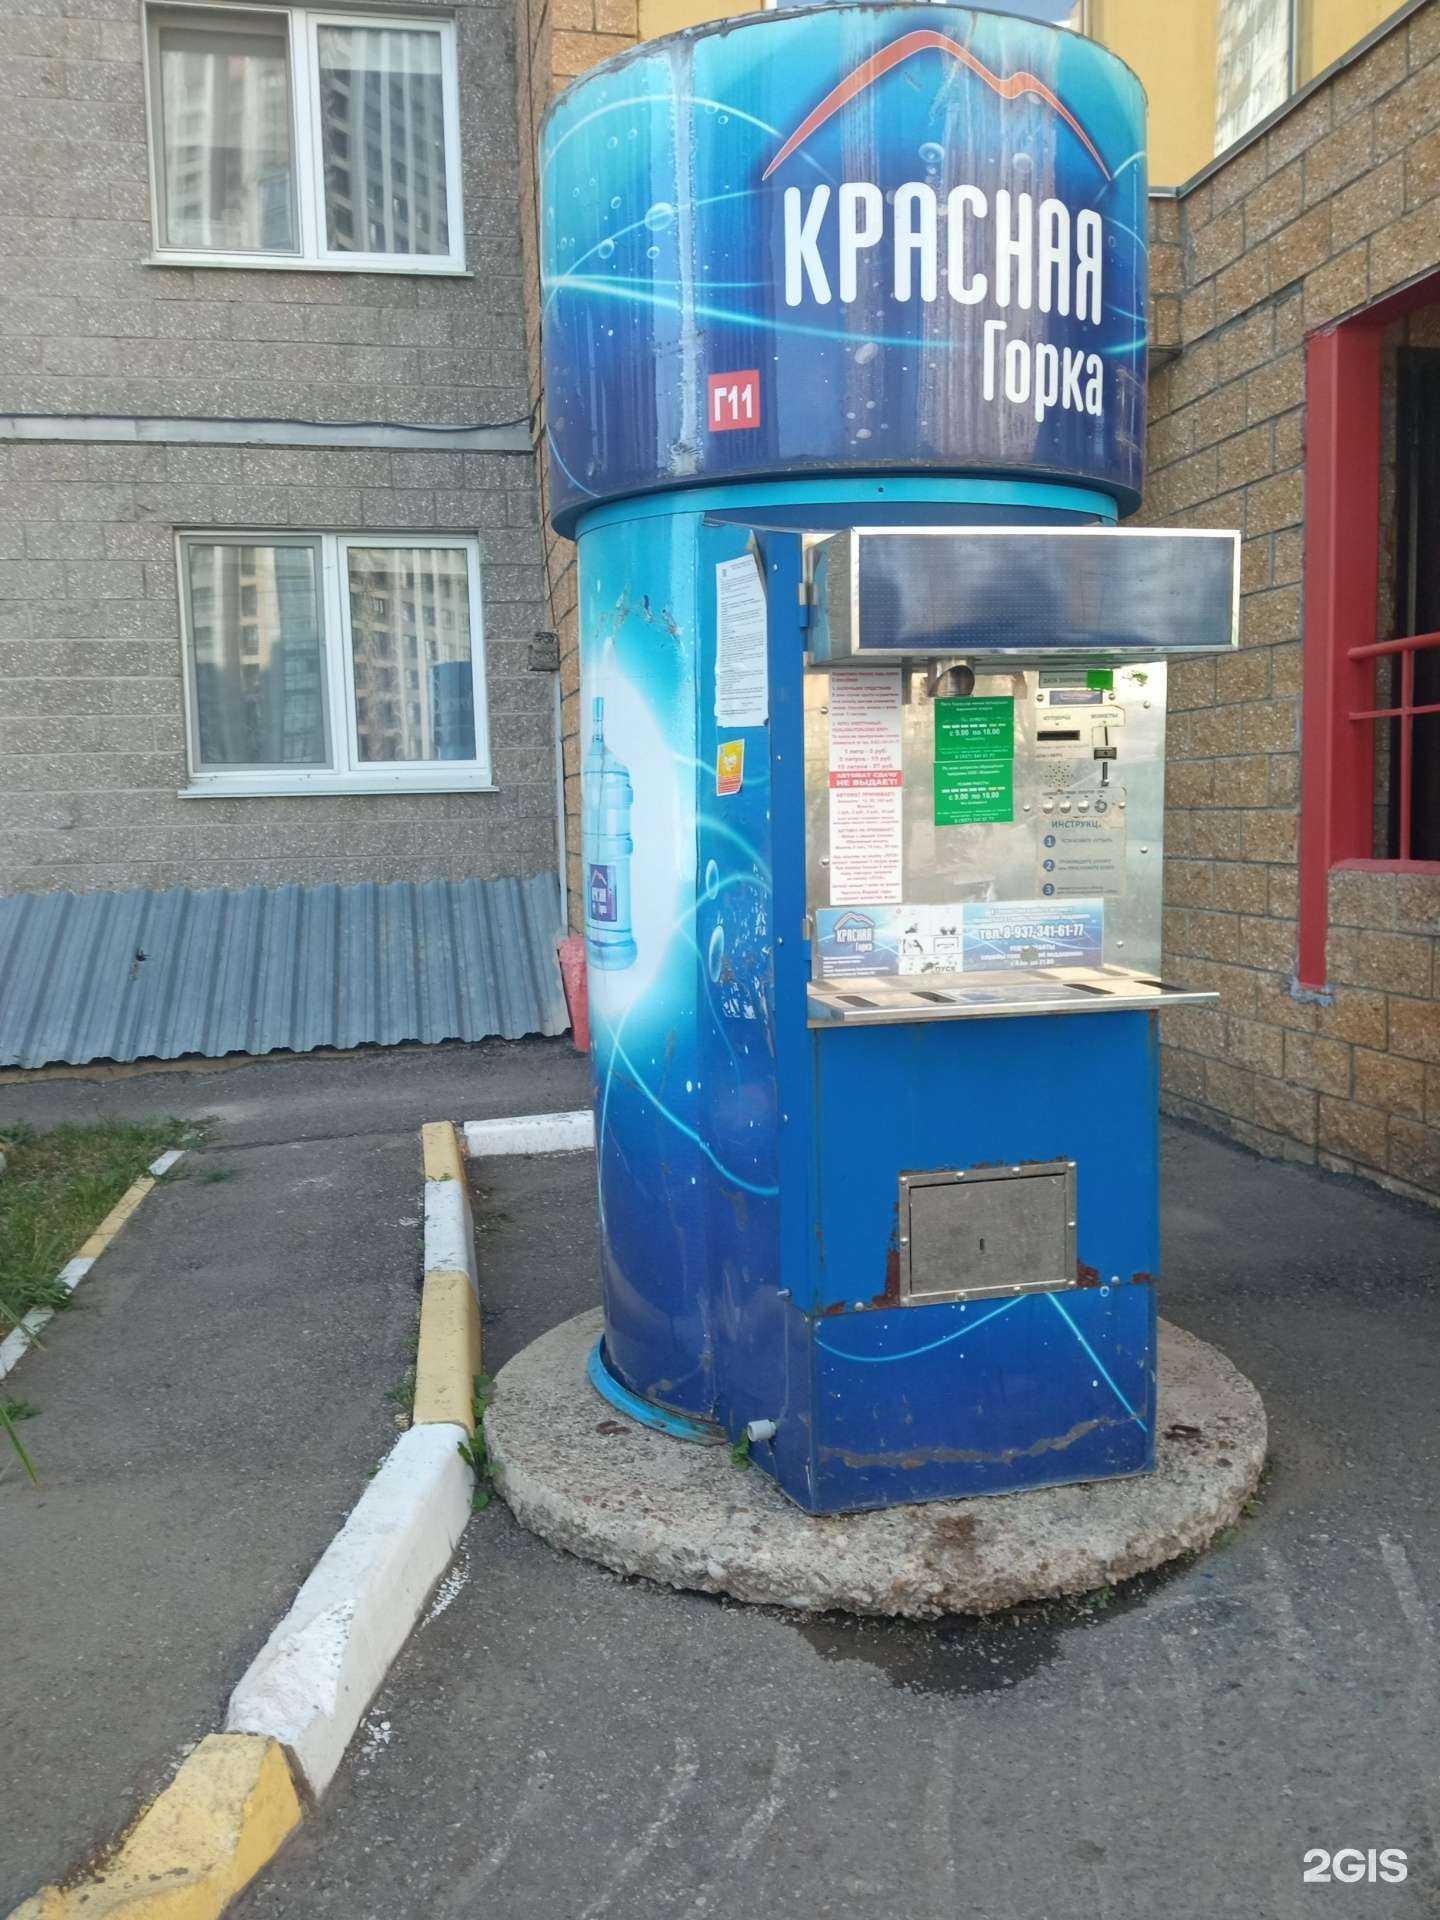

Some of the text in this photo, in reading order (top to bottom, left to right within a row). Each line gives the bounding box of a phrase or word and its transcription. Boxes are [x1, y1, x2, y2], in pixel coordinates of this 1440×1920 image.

[783, 182, 1103, 326] КРАСНАЯ
[983, 320, 1104, 423] Горка
[713, 384, 755, 422] Г11
[836, 779, 850, 787] НЕ
[836, 927, 873, 943] КРАСНАЯ
